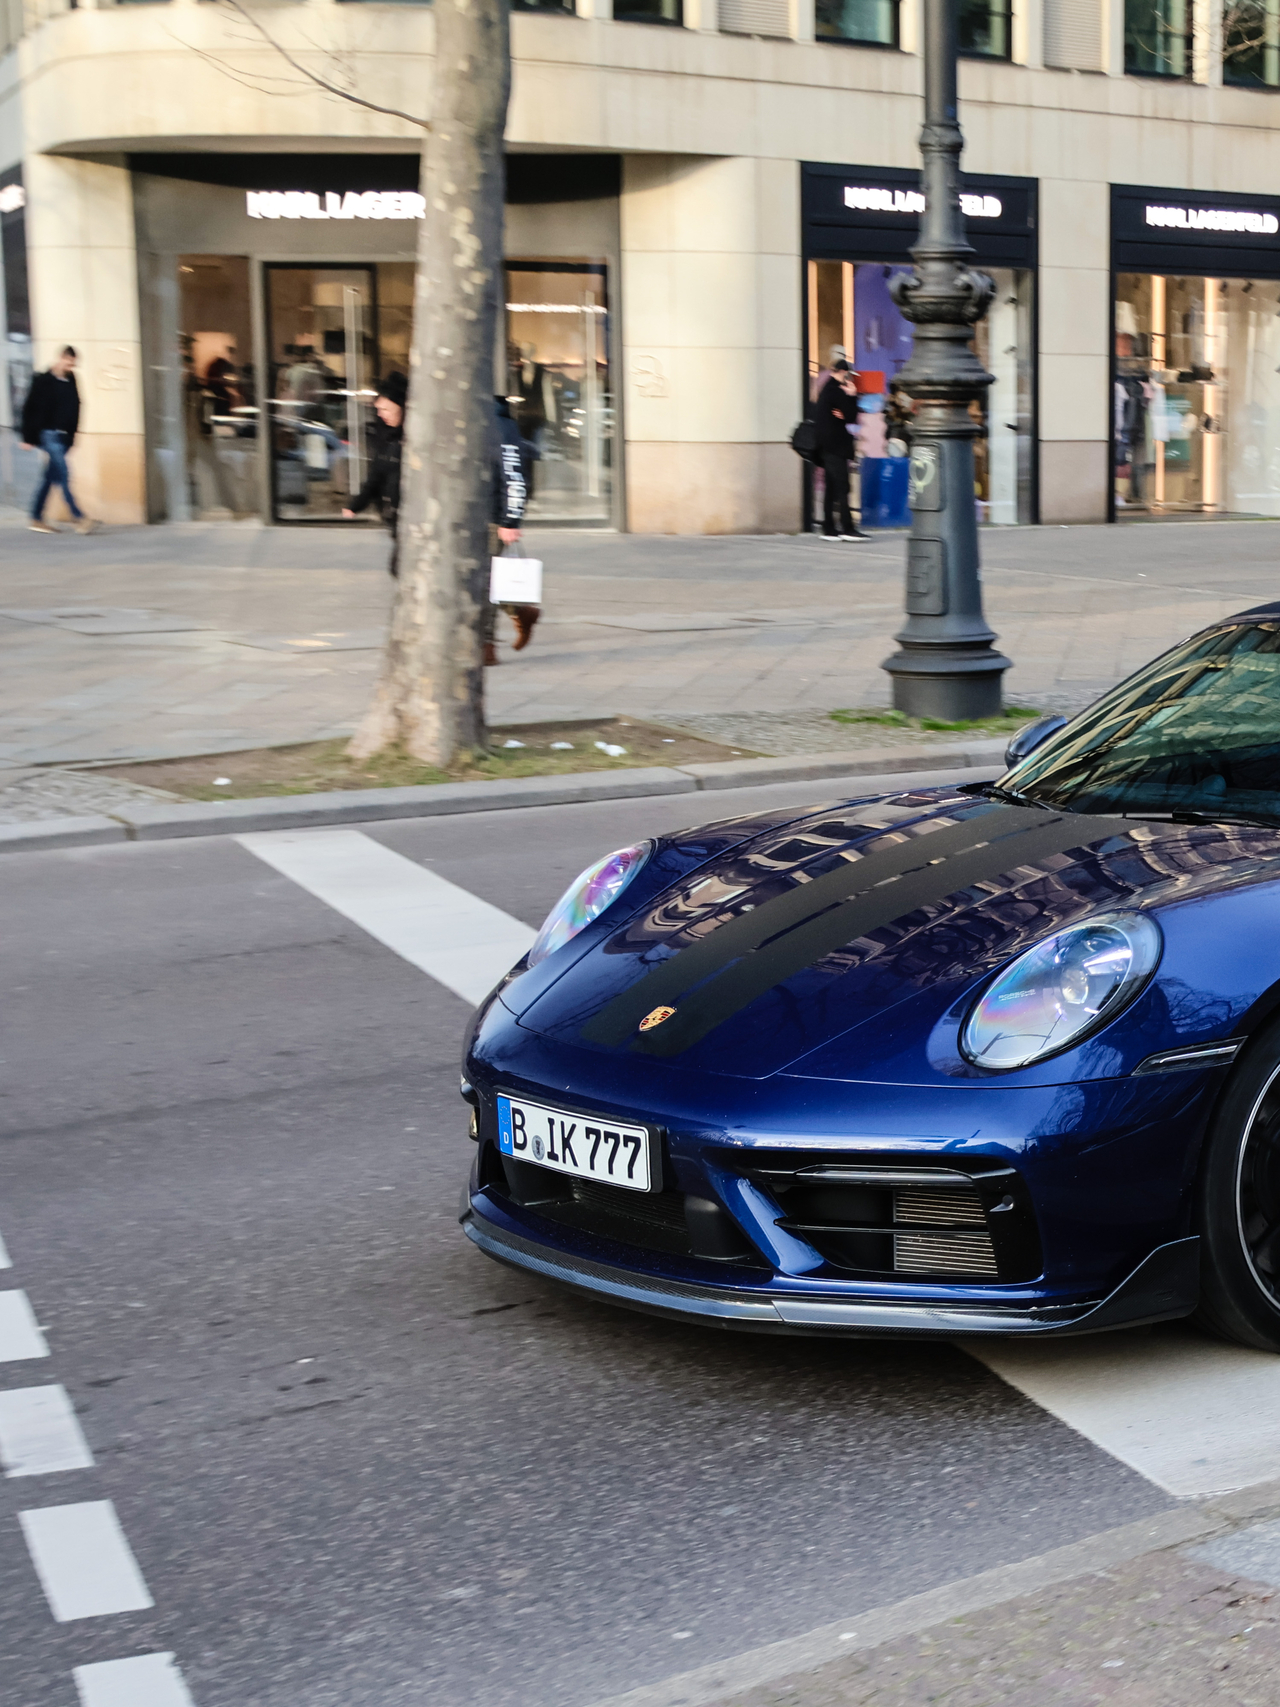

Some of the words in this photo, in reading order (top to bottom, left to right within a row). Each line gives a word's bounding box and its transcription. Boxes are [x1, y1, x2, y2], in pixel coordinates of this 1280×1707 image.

[1146, 206, 1190, 229] KARL
[1188, 209, 1279, 233] LAGERFELD
[500, 443, 526, 519] HILFIGER
[503, 1131, 509, 1144] D
[511, 1107, 528, 1151] B
[547, 1117, 579, 1168] IK
[585, 1126, 641, 1179] 777
